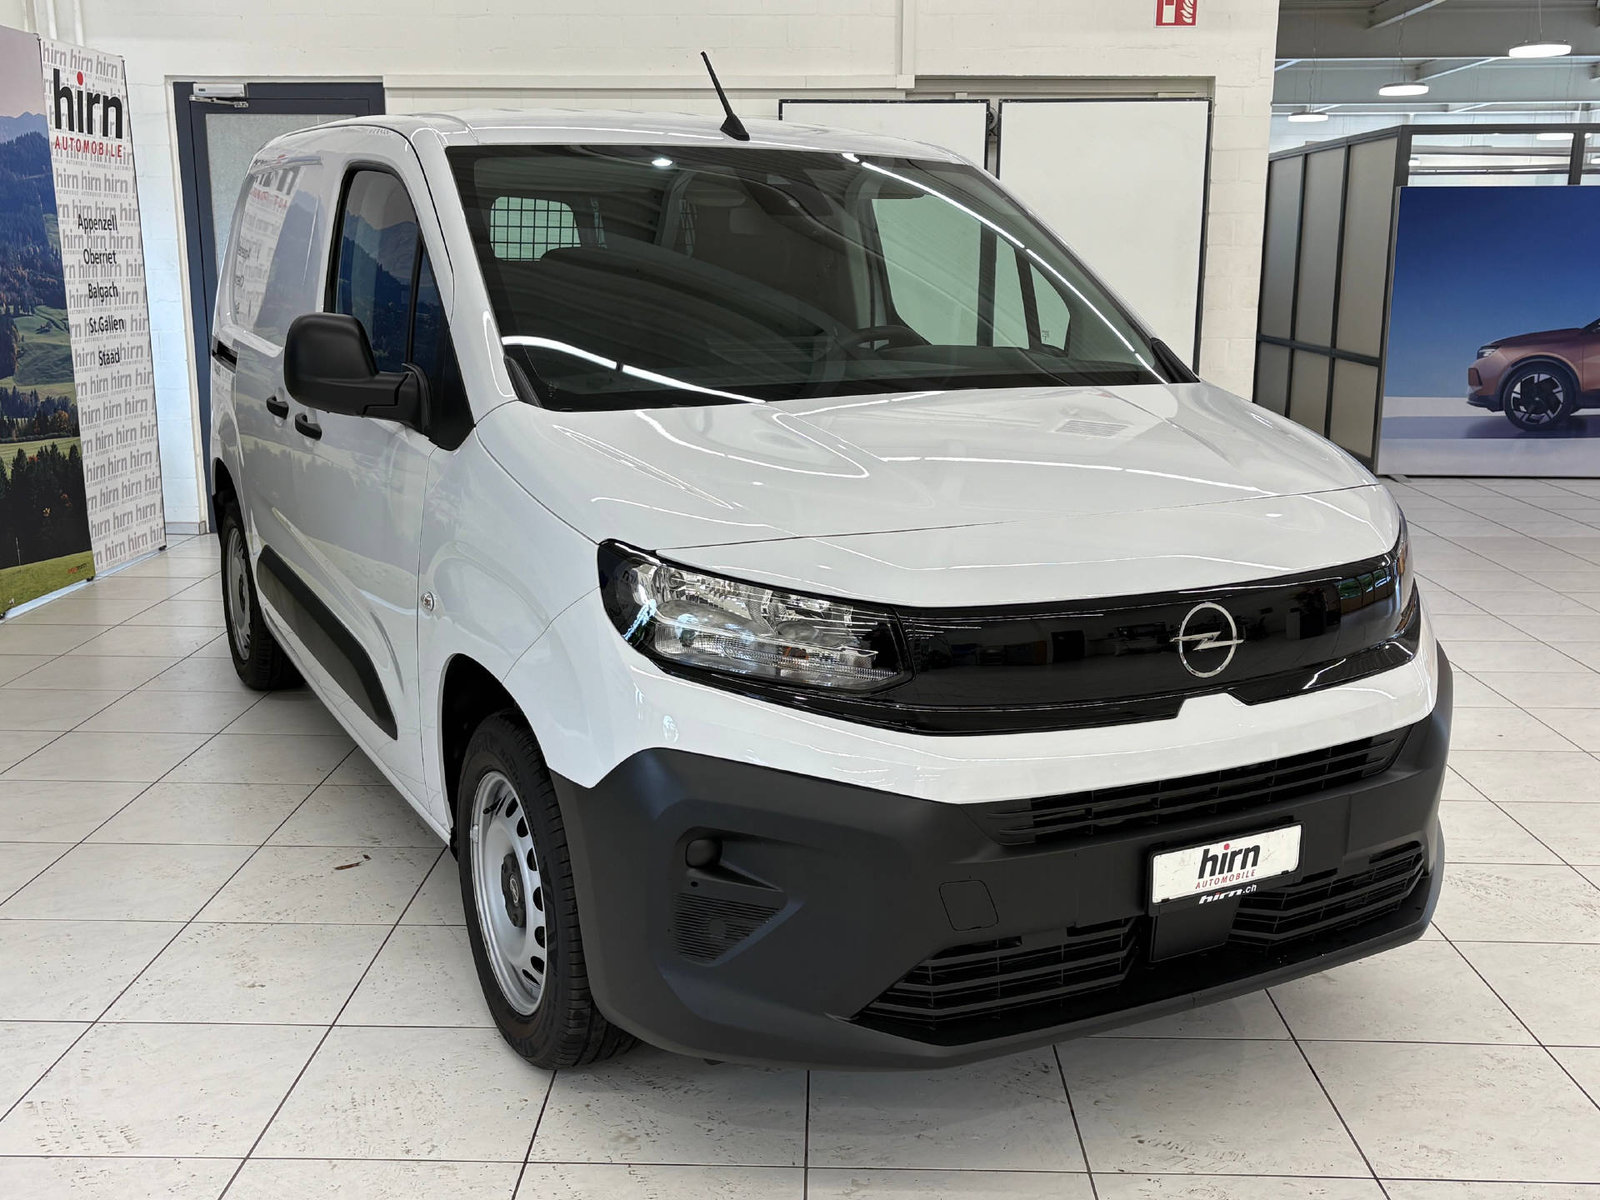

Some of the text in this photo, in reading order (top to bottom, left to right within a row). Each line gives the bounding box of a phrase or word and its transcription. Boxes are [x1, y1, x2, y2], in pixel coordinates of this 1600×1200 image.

[43, 41, 66, 66] hirn
[70, 49, 93, 73] hirn
[96, 55, 118, 79] hirn
[53, 68, 123, 139] hirn
[55, 135, 122, 158] AUTOMOBILE
[56, 168, 128, 193] hirn hirn hirn
[78, 213, 118, 234] Appenzell
[63, 228, 84, 249] hirn
[109, 231, 133, 249] hirn
[83, 248, 117, 265] Oberriet
[88, 281, 118, 303] Balgach
[89, 315, 124, 333] St.Gallen
[75, 347, 96, 368] hirn
[98, 346, 120, 366] Staad
[90, 374, 109, 395] hirn
[110, 370, 132, 390] hirn
[81, 405, 101, 426] hirn
[103, 400, 122, 421] hirn
[124, 395, 148, 415] hirn
[95, 430, 114, 451] hirn
[116, 424, 137, 445] hirn
[86, 461, 106, 483] hirn
[107, 454, 127, 476] hirn
[130, 448, 152, 469] hirn
[99, 486, 119, 507] hirn
[121, 478, 142, 499] hirn
[105, 540, 126, 562] hirn
[127, 532, 148, 552] hirn
[1198, 843, 1261, 880] hirn
[1195, 868, 1256, 890] AUTOMOBILE
